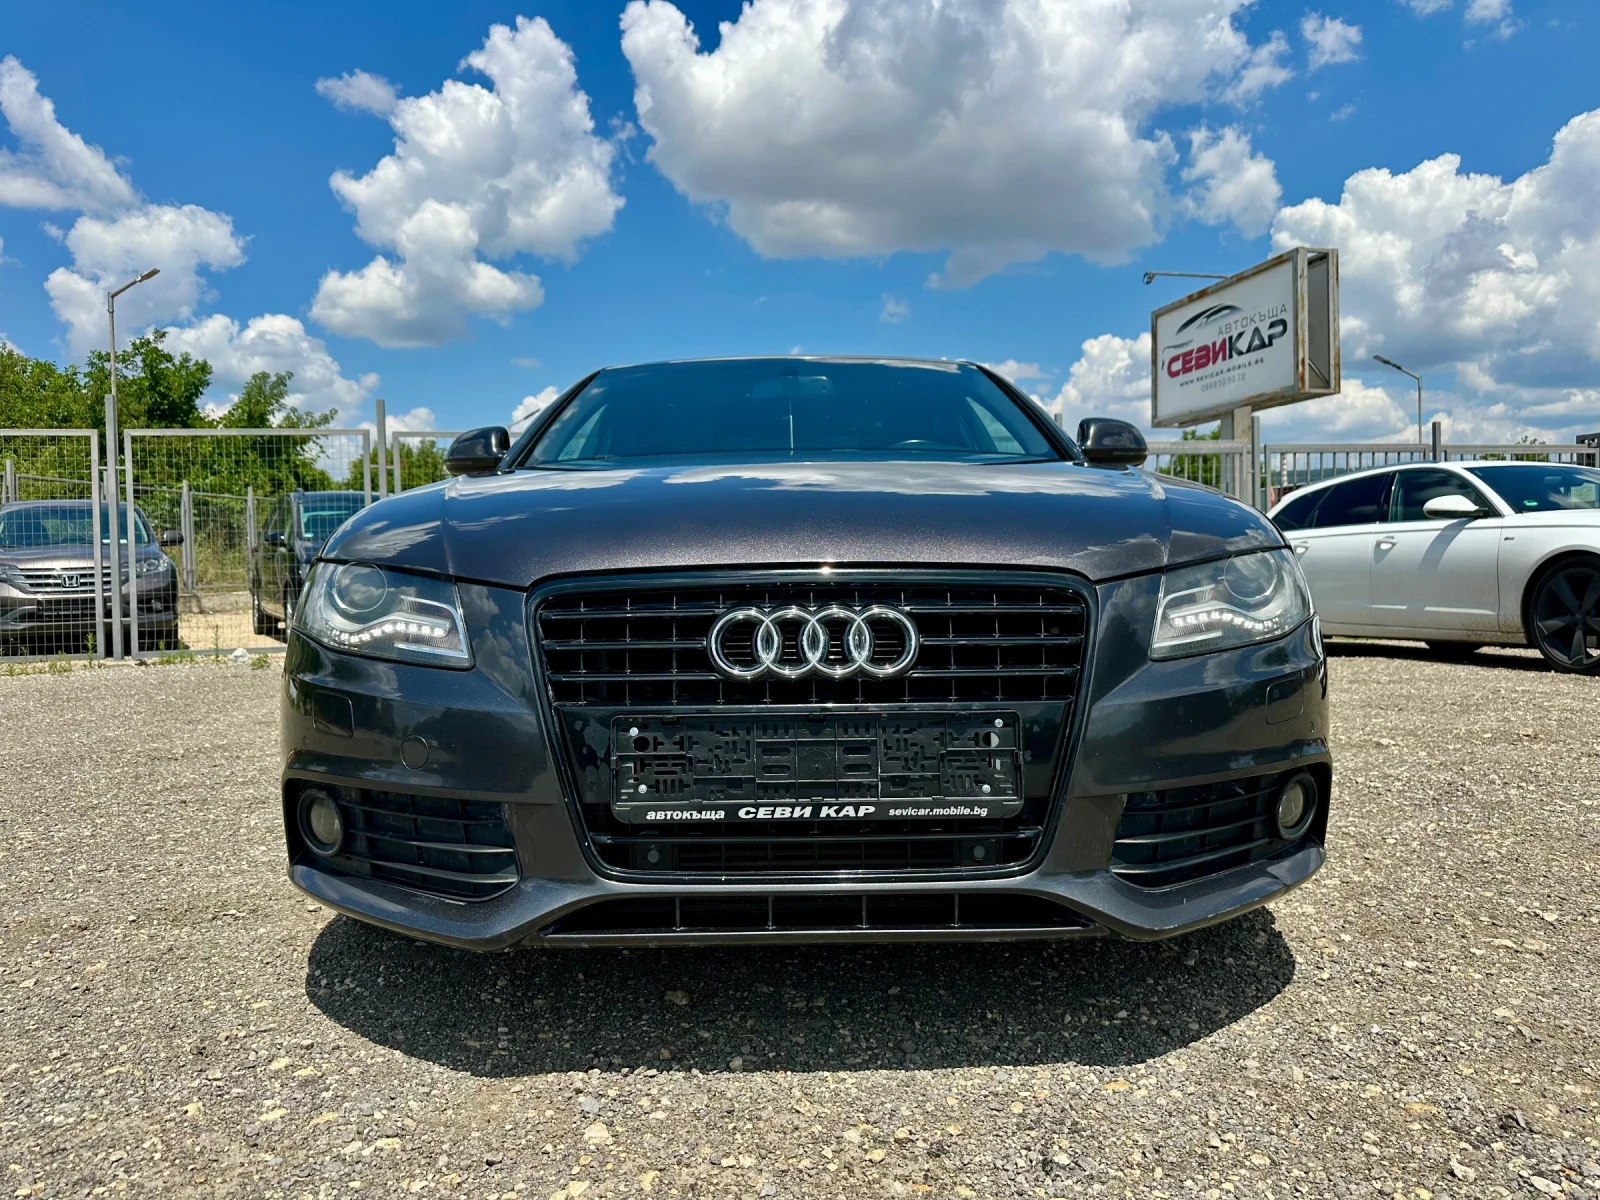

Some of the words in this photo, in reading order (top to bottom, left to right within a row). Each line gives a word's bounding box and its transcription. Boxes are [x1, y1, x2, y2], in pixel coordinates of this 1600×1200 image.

[1218, 303, 1288, 337] АВТОКЪЩА
[646, 810, 726, 821] автокъща
[738, 806, 813, 819] СЕВИ
[819, 805, 876, 818] КАР
[888, 806, 989, 817] sevicar.mobile.bg
